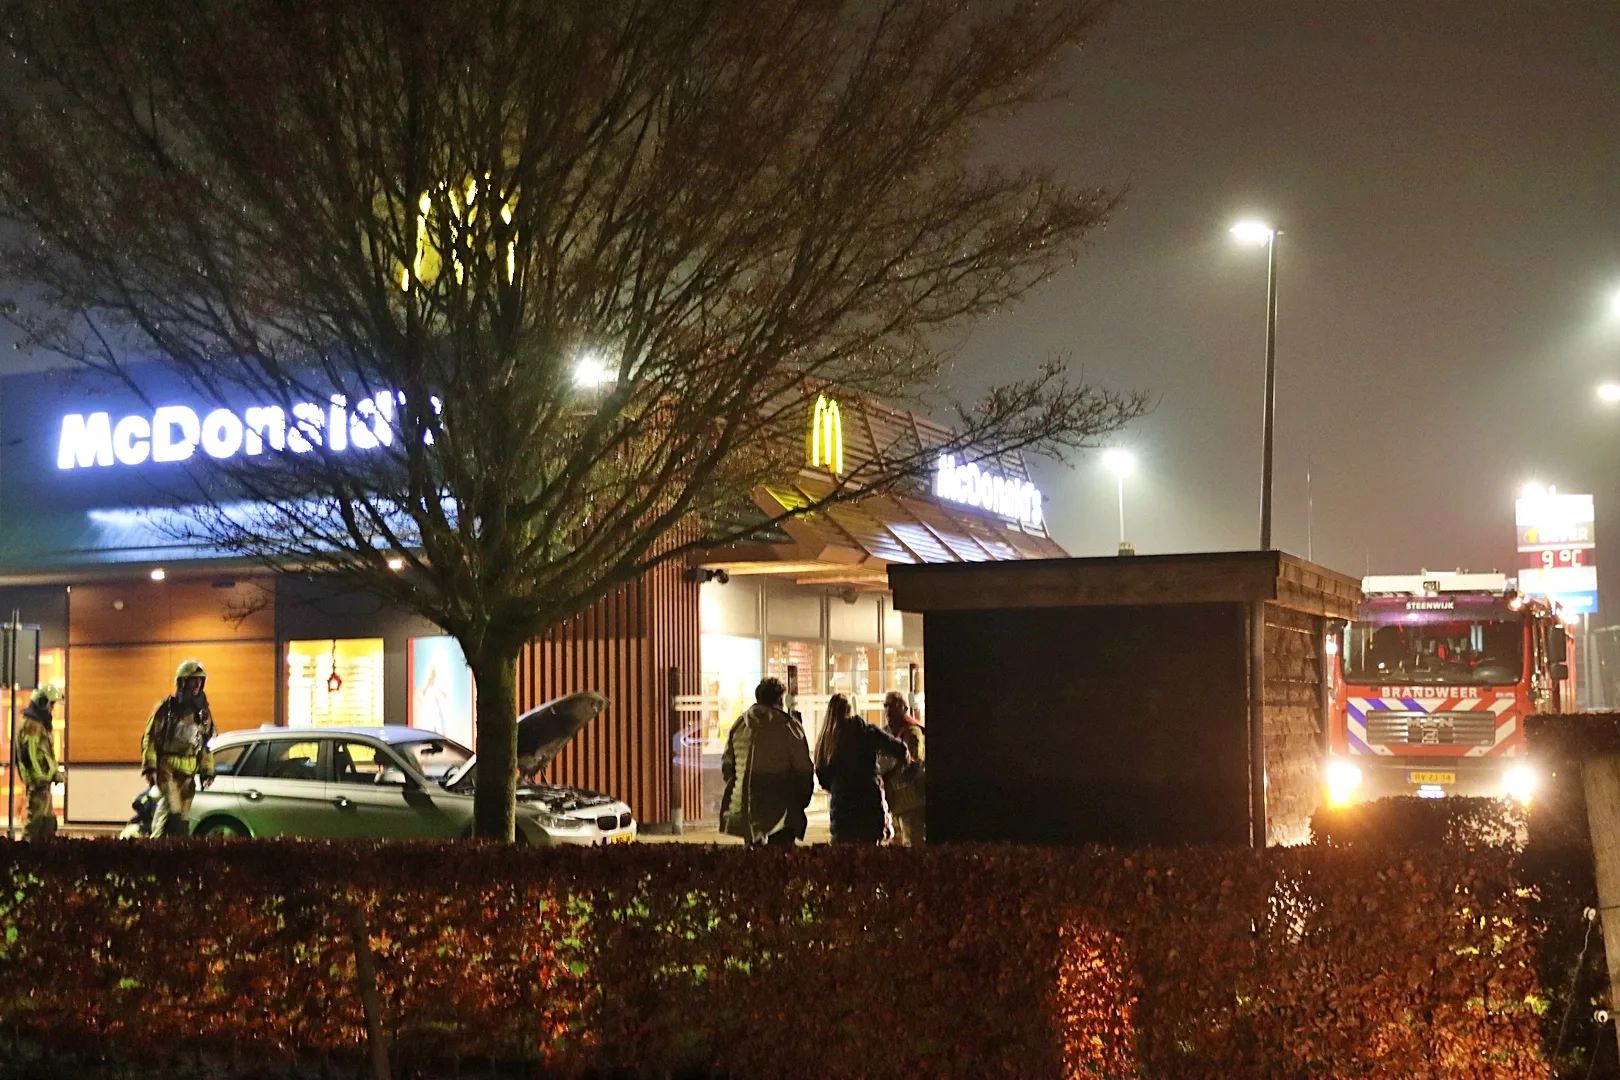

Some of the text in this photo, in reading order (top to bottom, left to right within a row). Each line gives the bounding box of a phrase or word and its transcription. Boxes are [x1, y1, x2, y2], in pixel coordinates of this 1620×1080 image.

[1405, 601, 1455, 610] STEENWIJK
[1381, 686, 1478, 699] BRANDWEER
[1406, 716, 1454, 728] MAN
